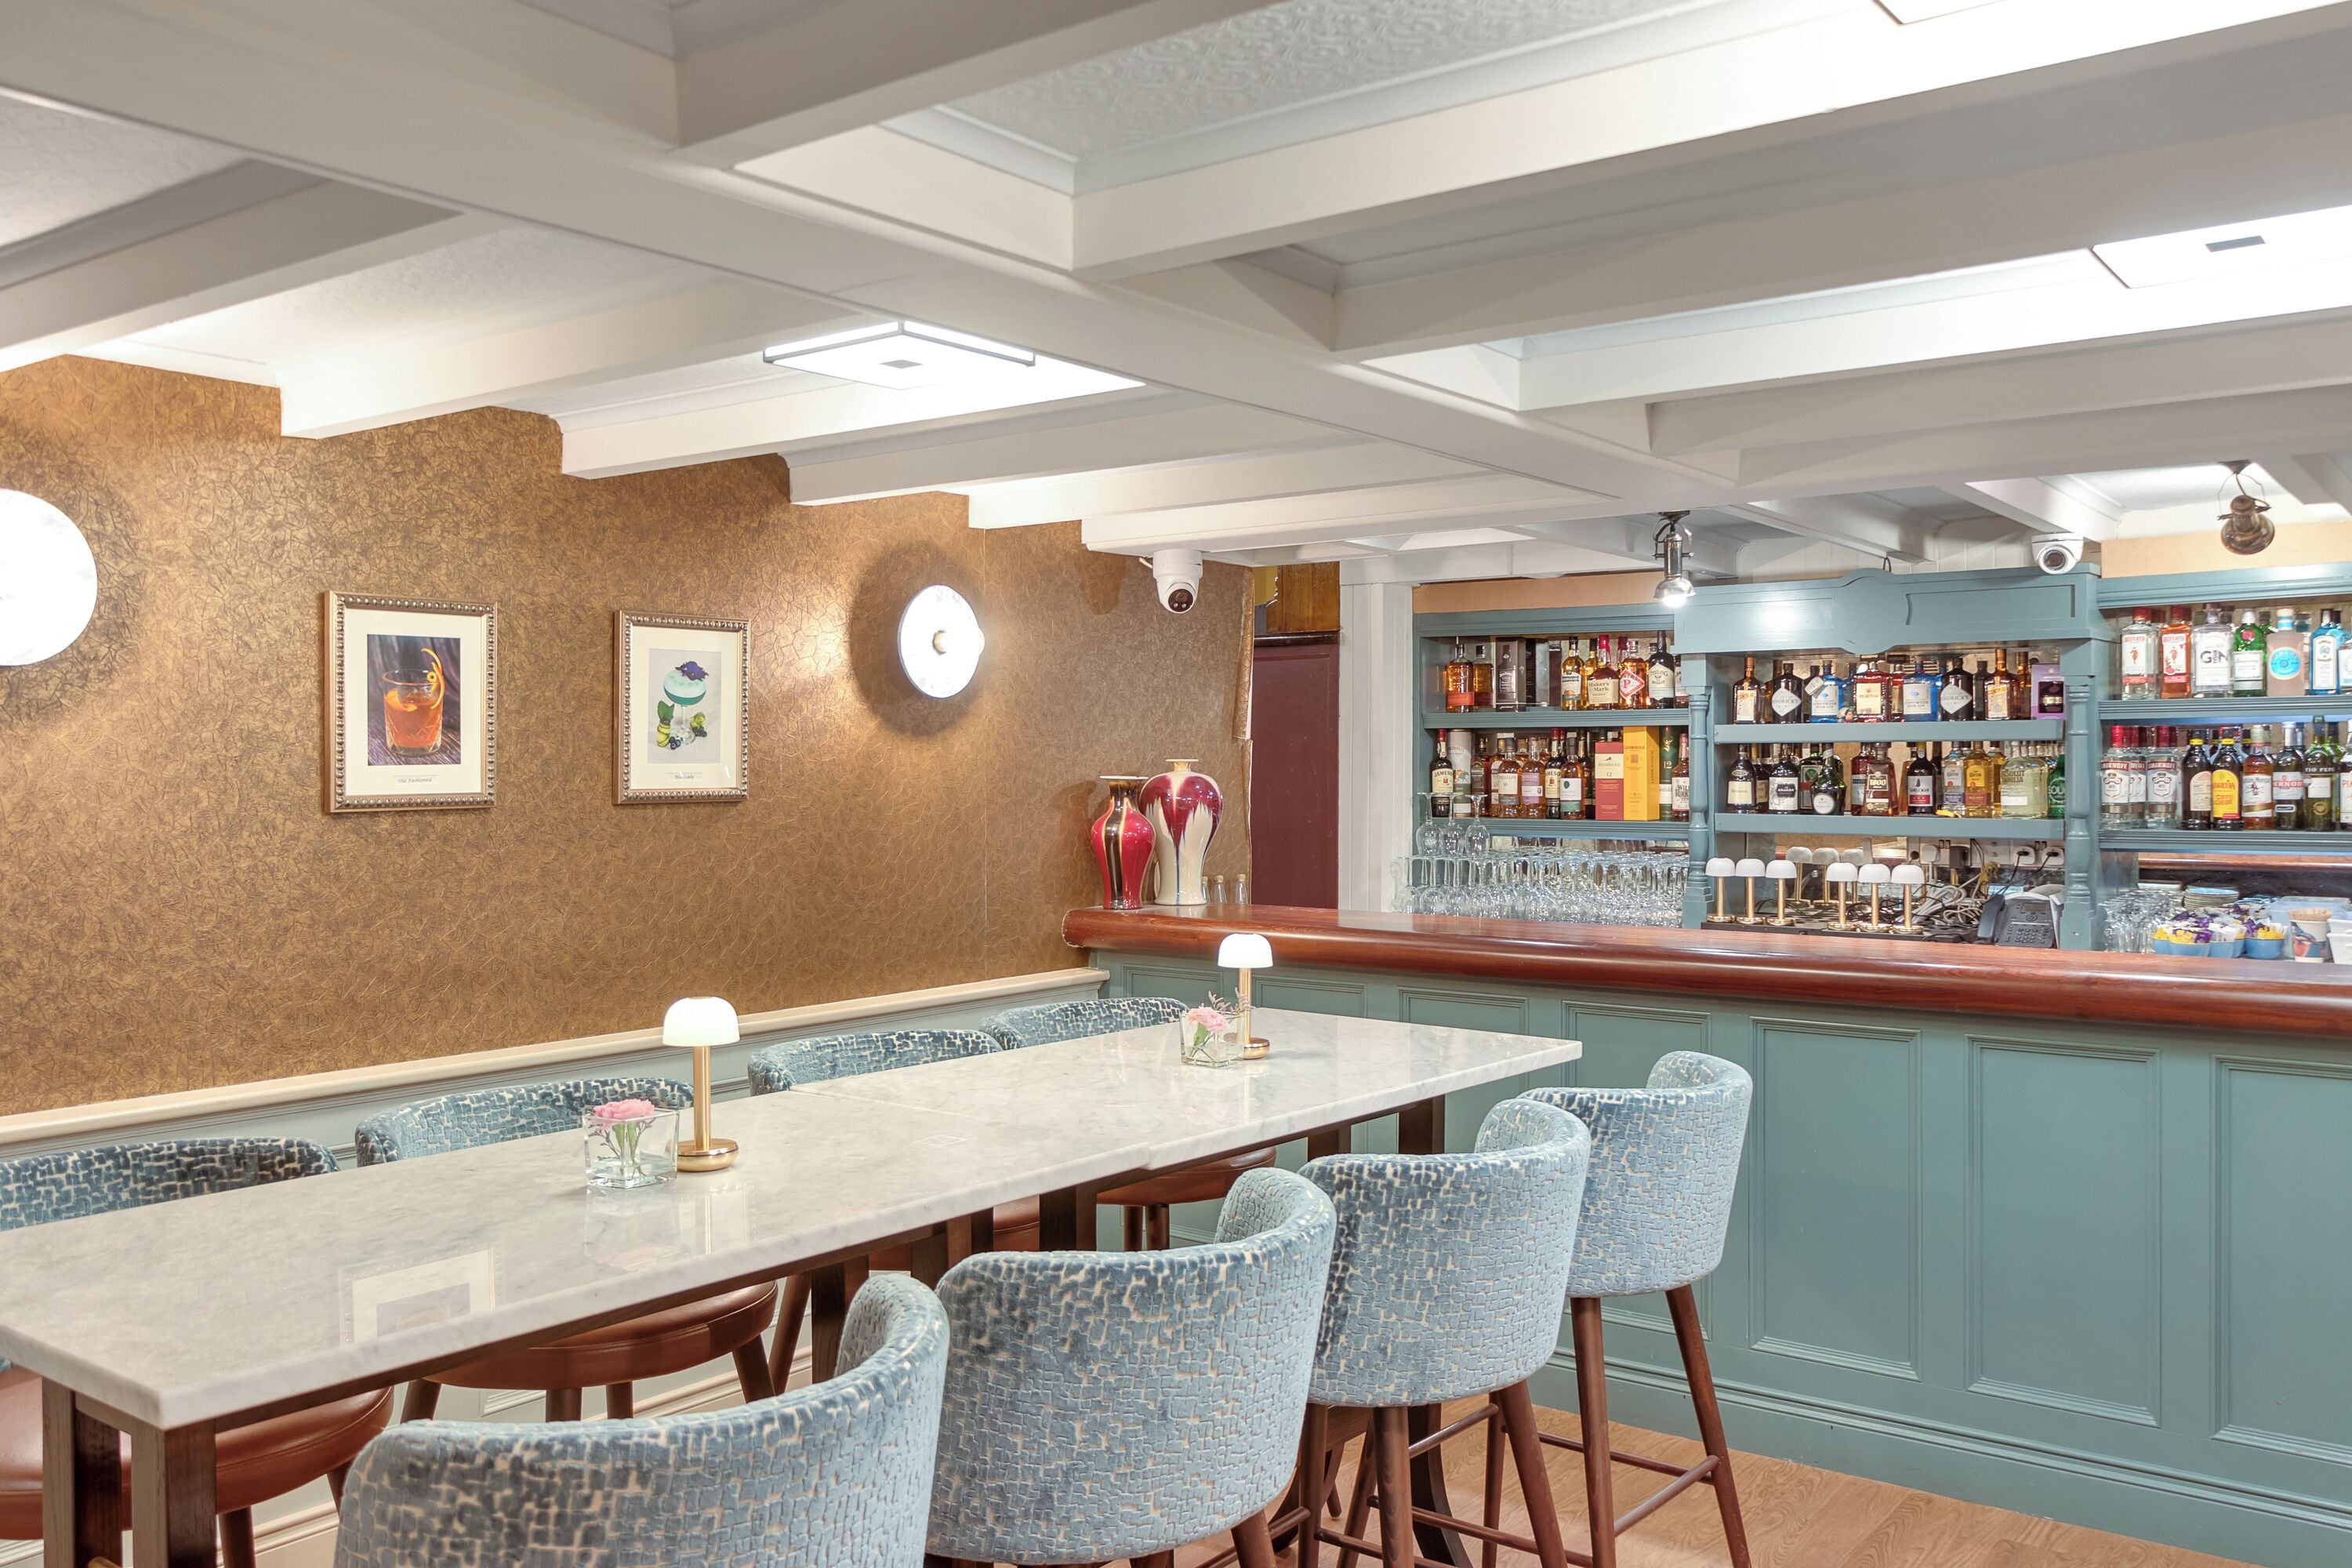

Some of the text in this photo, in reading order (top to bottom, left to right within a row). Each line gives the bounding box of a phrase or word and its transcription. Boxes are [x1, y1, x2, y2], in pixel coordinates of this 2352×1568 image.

[1623, 679, 1631, 689] P
[1663, 760, 1672, 769] 12
[1677, 784, 1689, 793] WIL
[2048, 785, 2064, 794] SOU
